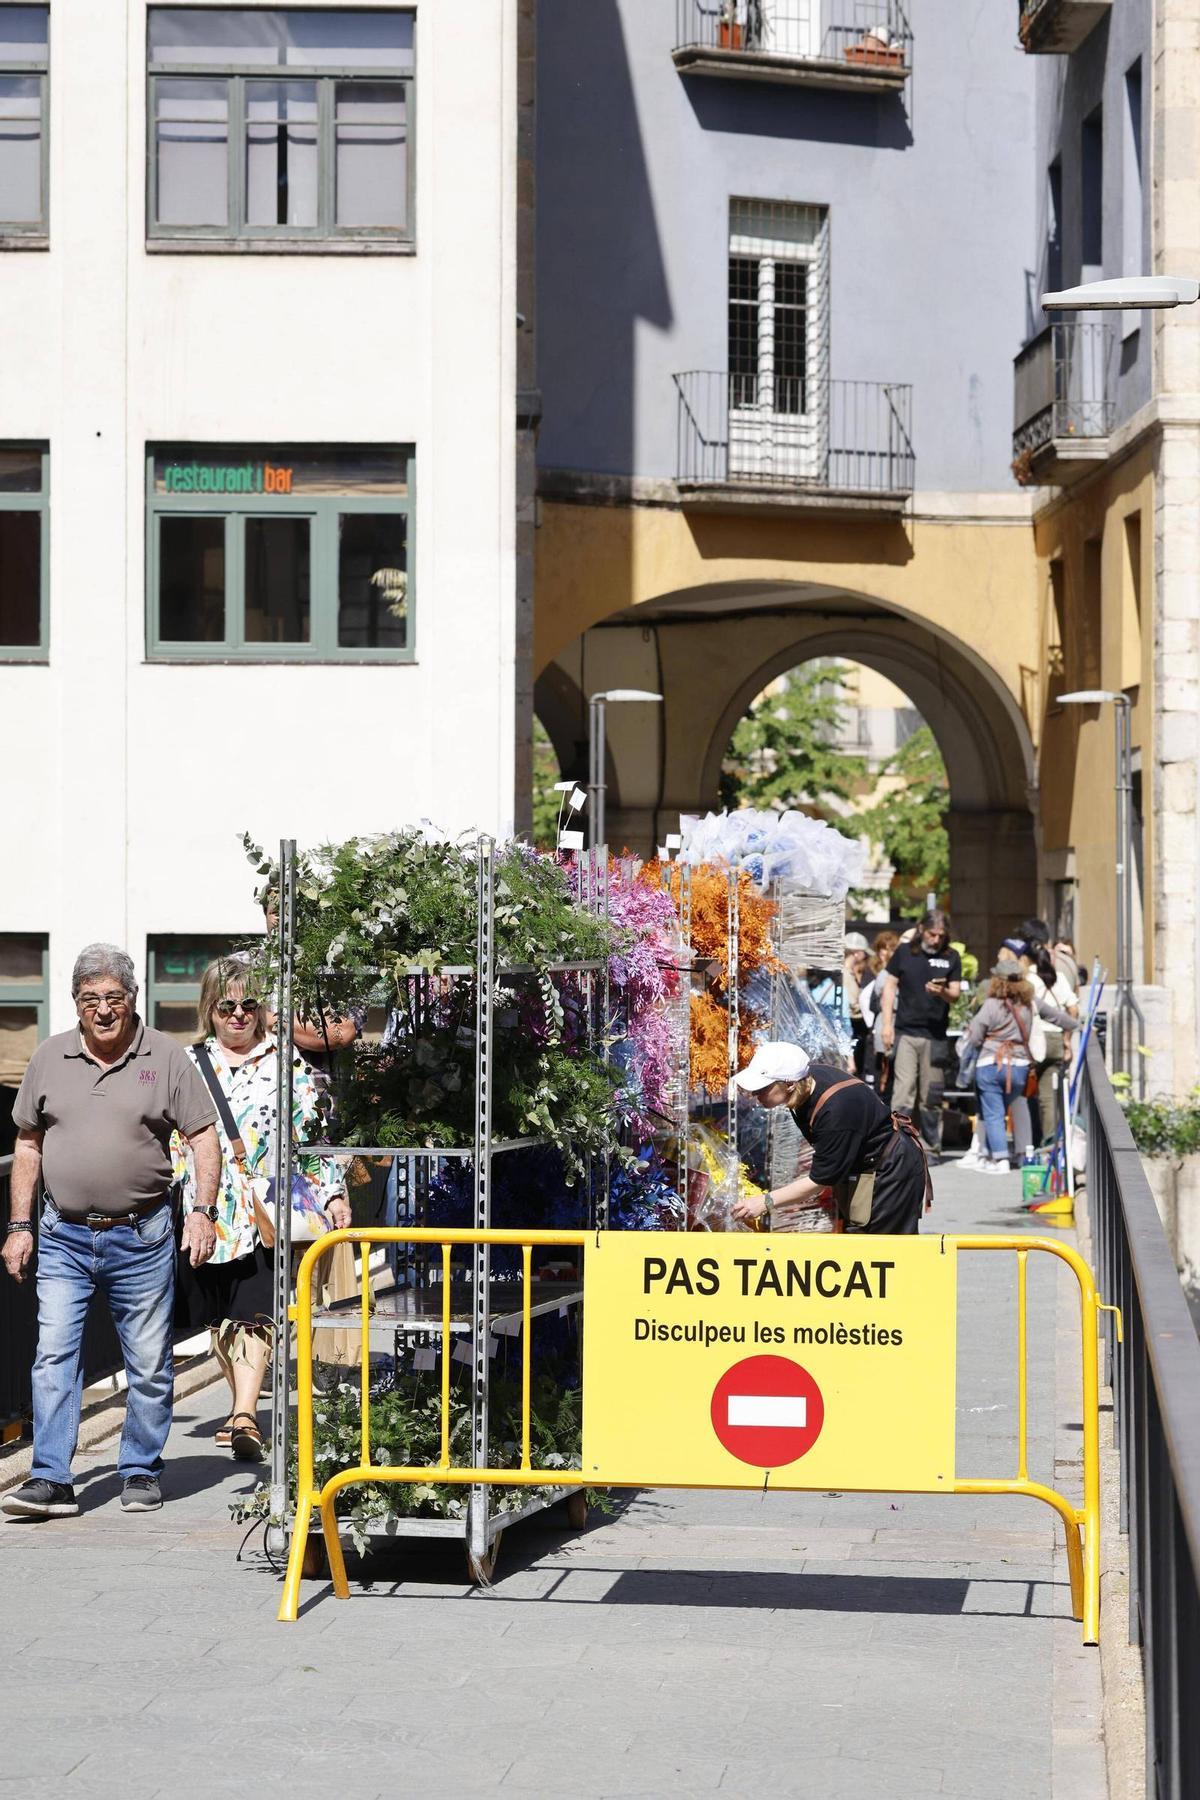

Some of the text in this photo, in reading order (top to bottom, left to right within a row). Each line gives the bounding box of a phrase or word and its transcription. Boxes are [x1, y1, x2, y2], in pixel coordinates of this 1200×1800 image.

[164, 461, 253, 492] restaurant
[264, 461, 292, 493] bar
[643, 1257, 895, 1298] PAS TANCAT
[634, 1318, 903, 1347] Disculpeu les molèsties
